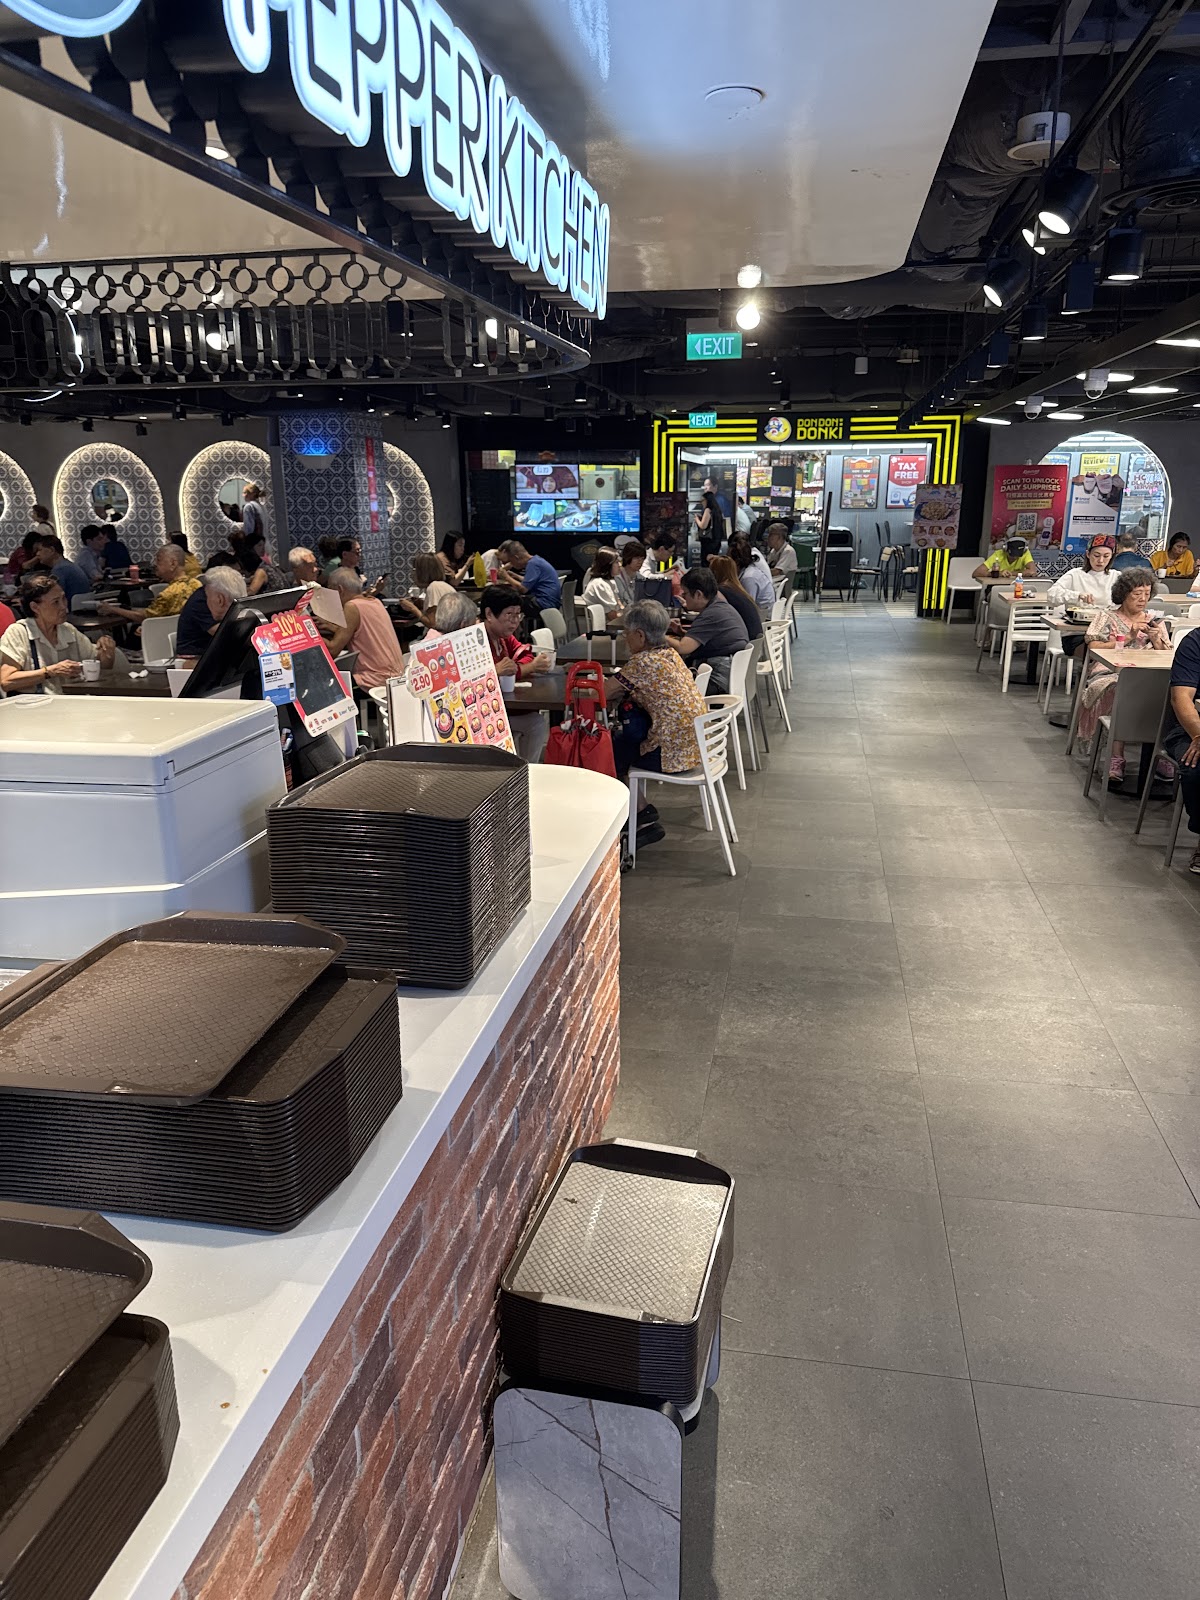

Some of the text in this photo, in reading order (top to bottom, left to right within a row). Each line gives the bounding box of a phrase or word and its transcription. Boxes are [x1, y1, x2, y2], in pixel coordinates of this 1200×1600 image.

[224, 0, 489, 228] EPPER
[491, 80, 609, 318] KITCHEN
[703, 336, 735, 356] EXIT
[695, 415, 715, 426] EXIT
[796, 427, 844, 441] DONKI
[897, 462, 918, 471] TAX
[894, 471, 920, 480] FREE
[1000, 483, 1061, 492] DAILY SURPRISES
[274, 613, 304, 637] 10%
[410, 673, 431, 691] $2.90
